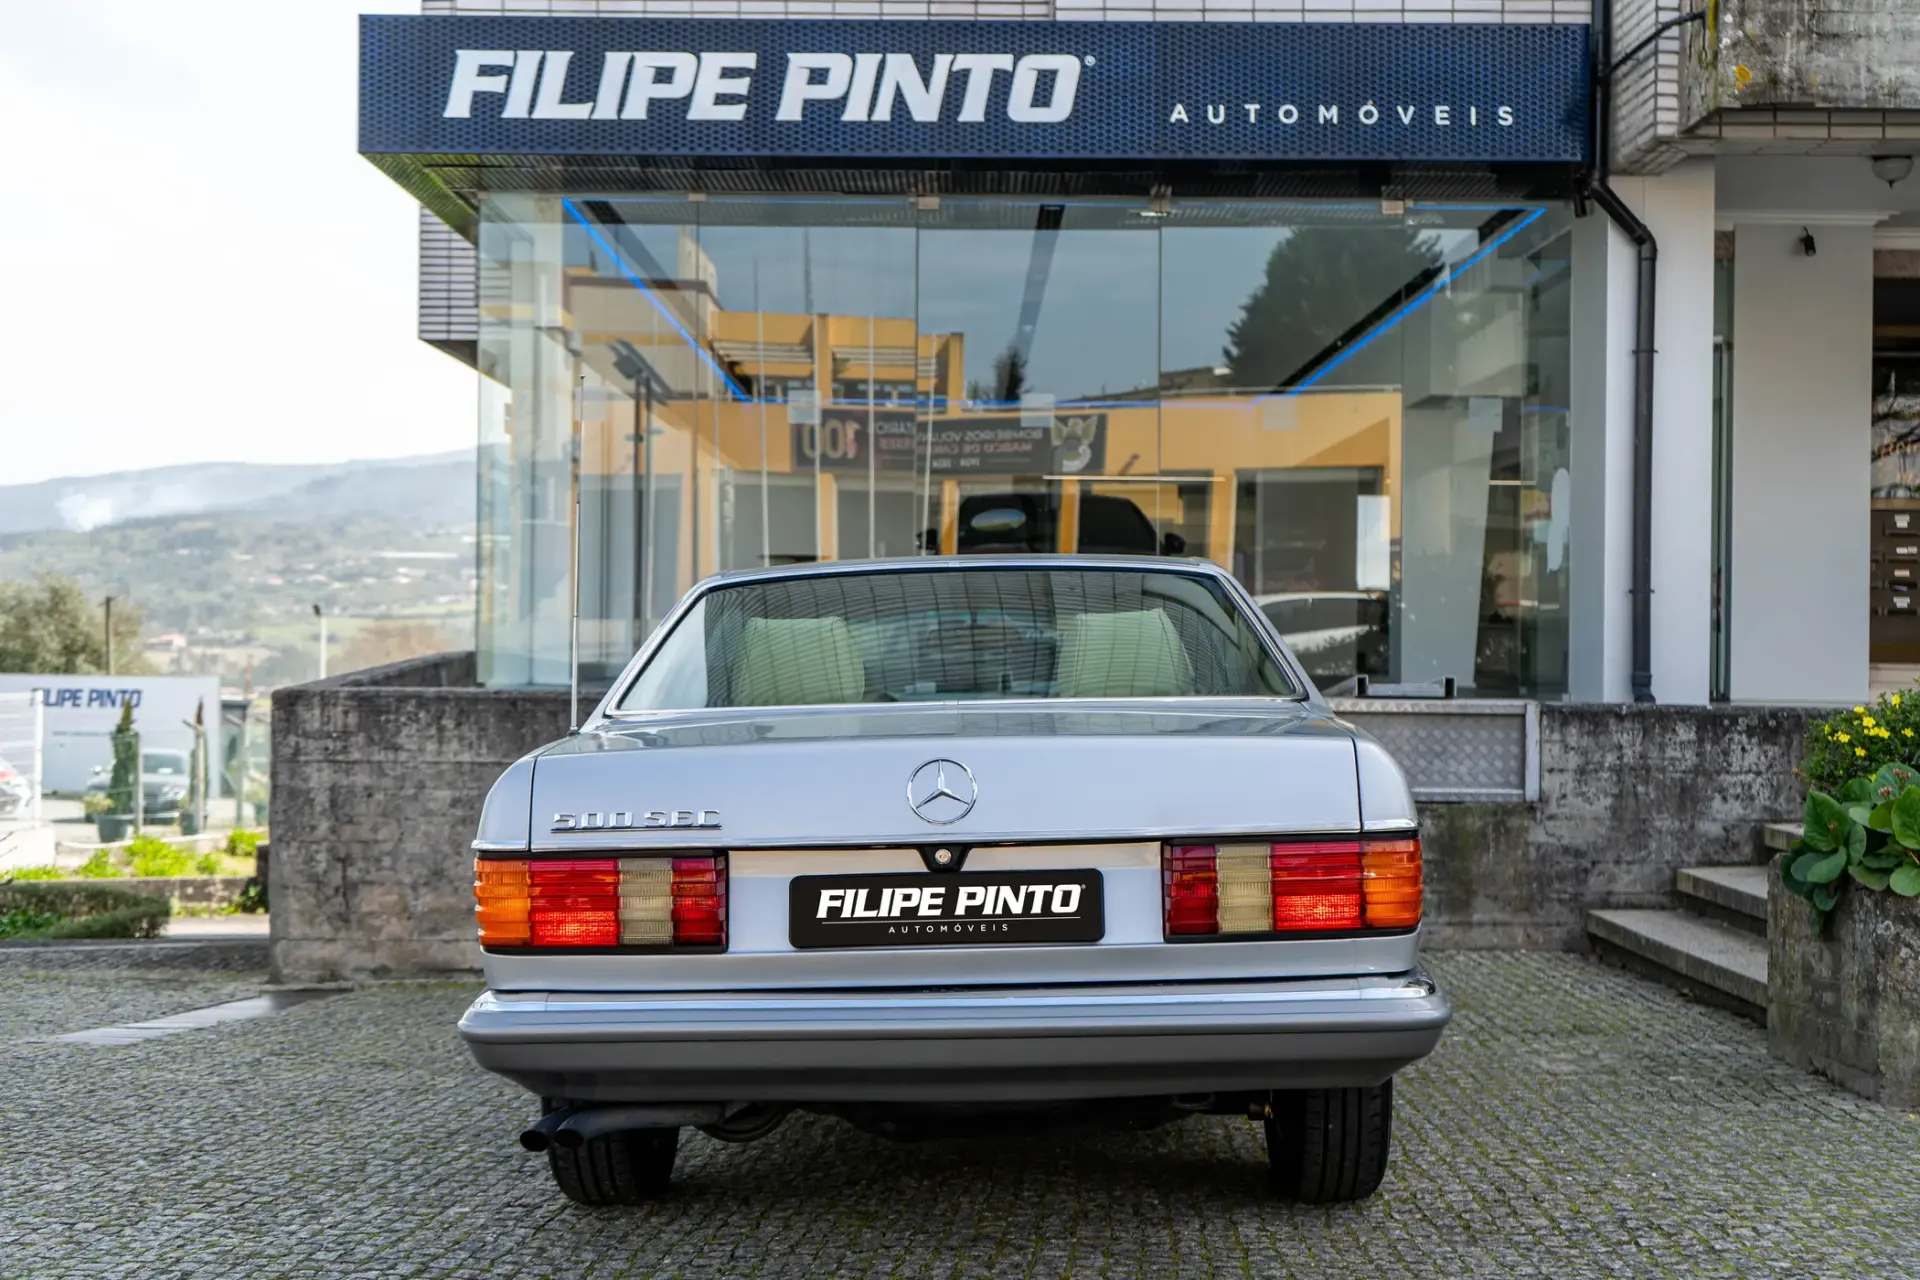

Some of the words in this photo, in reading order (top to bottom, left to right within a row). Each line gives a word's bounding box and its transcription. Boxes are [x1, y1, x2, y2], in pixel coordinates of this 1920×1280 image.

[442, 49, 757, 121] FILIPE
[775, 52, 1083, 123] PINTO
[1169, 99, 1515, 127] AUTOMÓVEIS
[87, 688, 142, 709] PINTO
[553, 812, 633, 830] 500
[644, 809, 720, 828] SEC
[815, 886, 946, 919] FILIPE
[954, 883, 1082, 917] PINTO
[888, 922, 1010, 935] AUTOMÓVEIS
